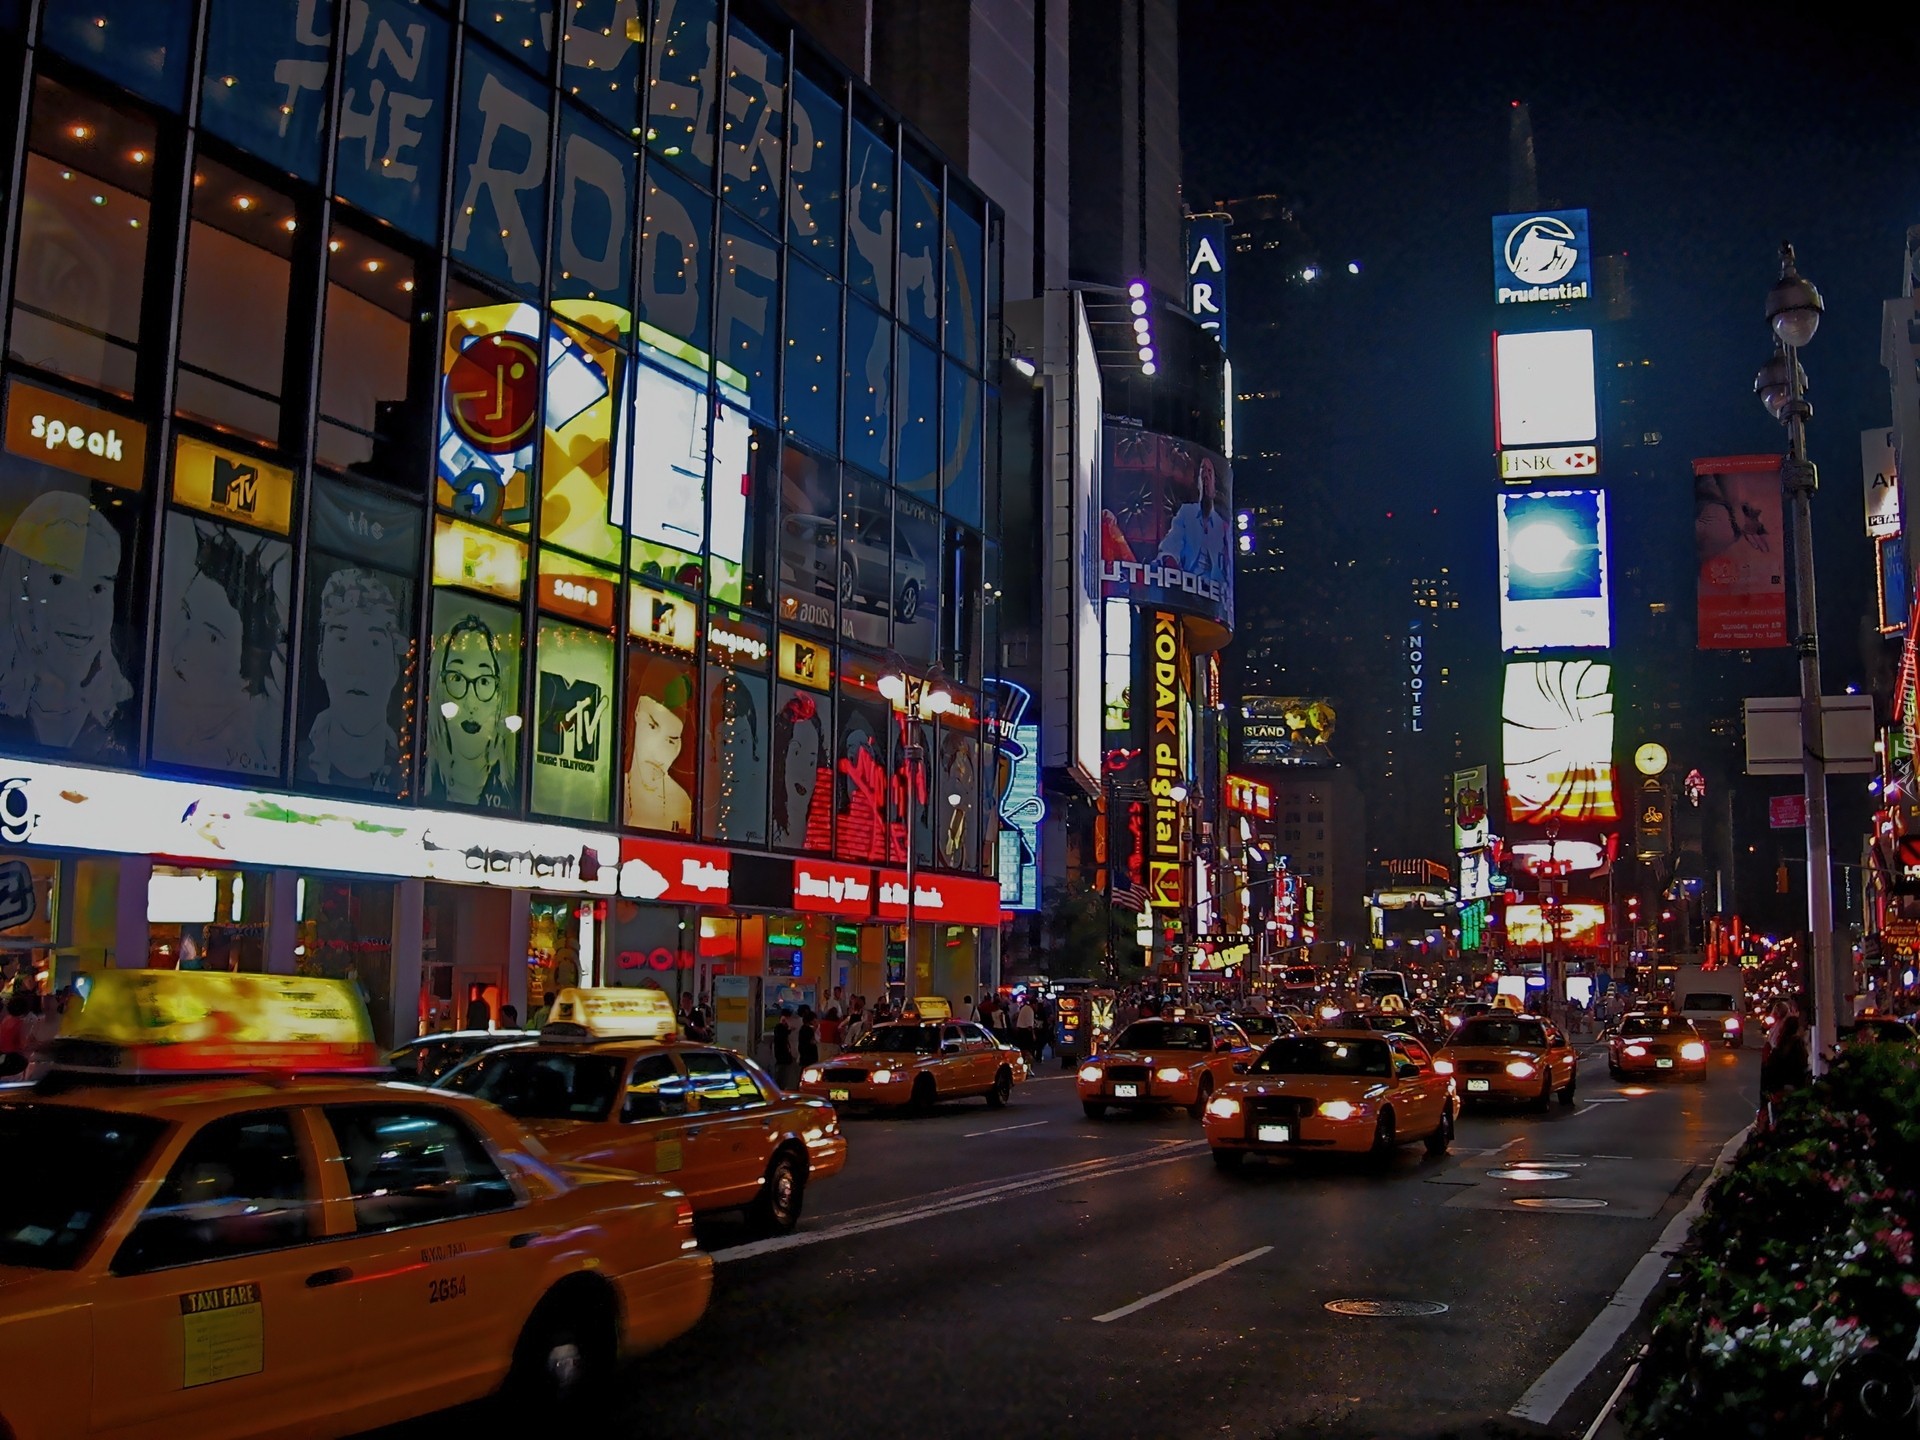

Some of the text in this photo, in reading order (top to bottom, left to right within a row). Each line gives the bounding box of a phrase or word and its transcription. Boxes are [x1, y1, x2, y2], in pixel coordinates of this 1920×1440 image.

[274, 59, 433, 182] THE
[1190, 237, 1222, 342] AR
[1498, 281, 1588, 304] Prudential
[31, 415, 122, 461] speak
[347, 511, 384, 540] the
[708, 622, 767, 660] language
[1409, 635, 1423, 732] NOVOTEL
[538, 670, 609, 762] MTV
[1150, 610, 1178, 855] KODAK digital
[1243, 725, 1286, 738] ISLAND
[188, 1284, 257, 1312] TAXI FARE
